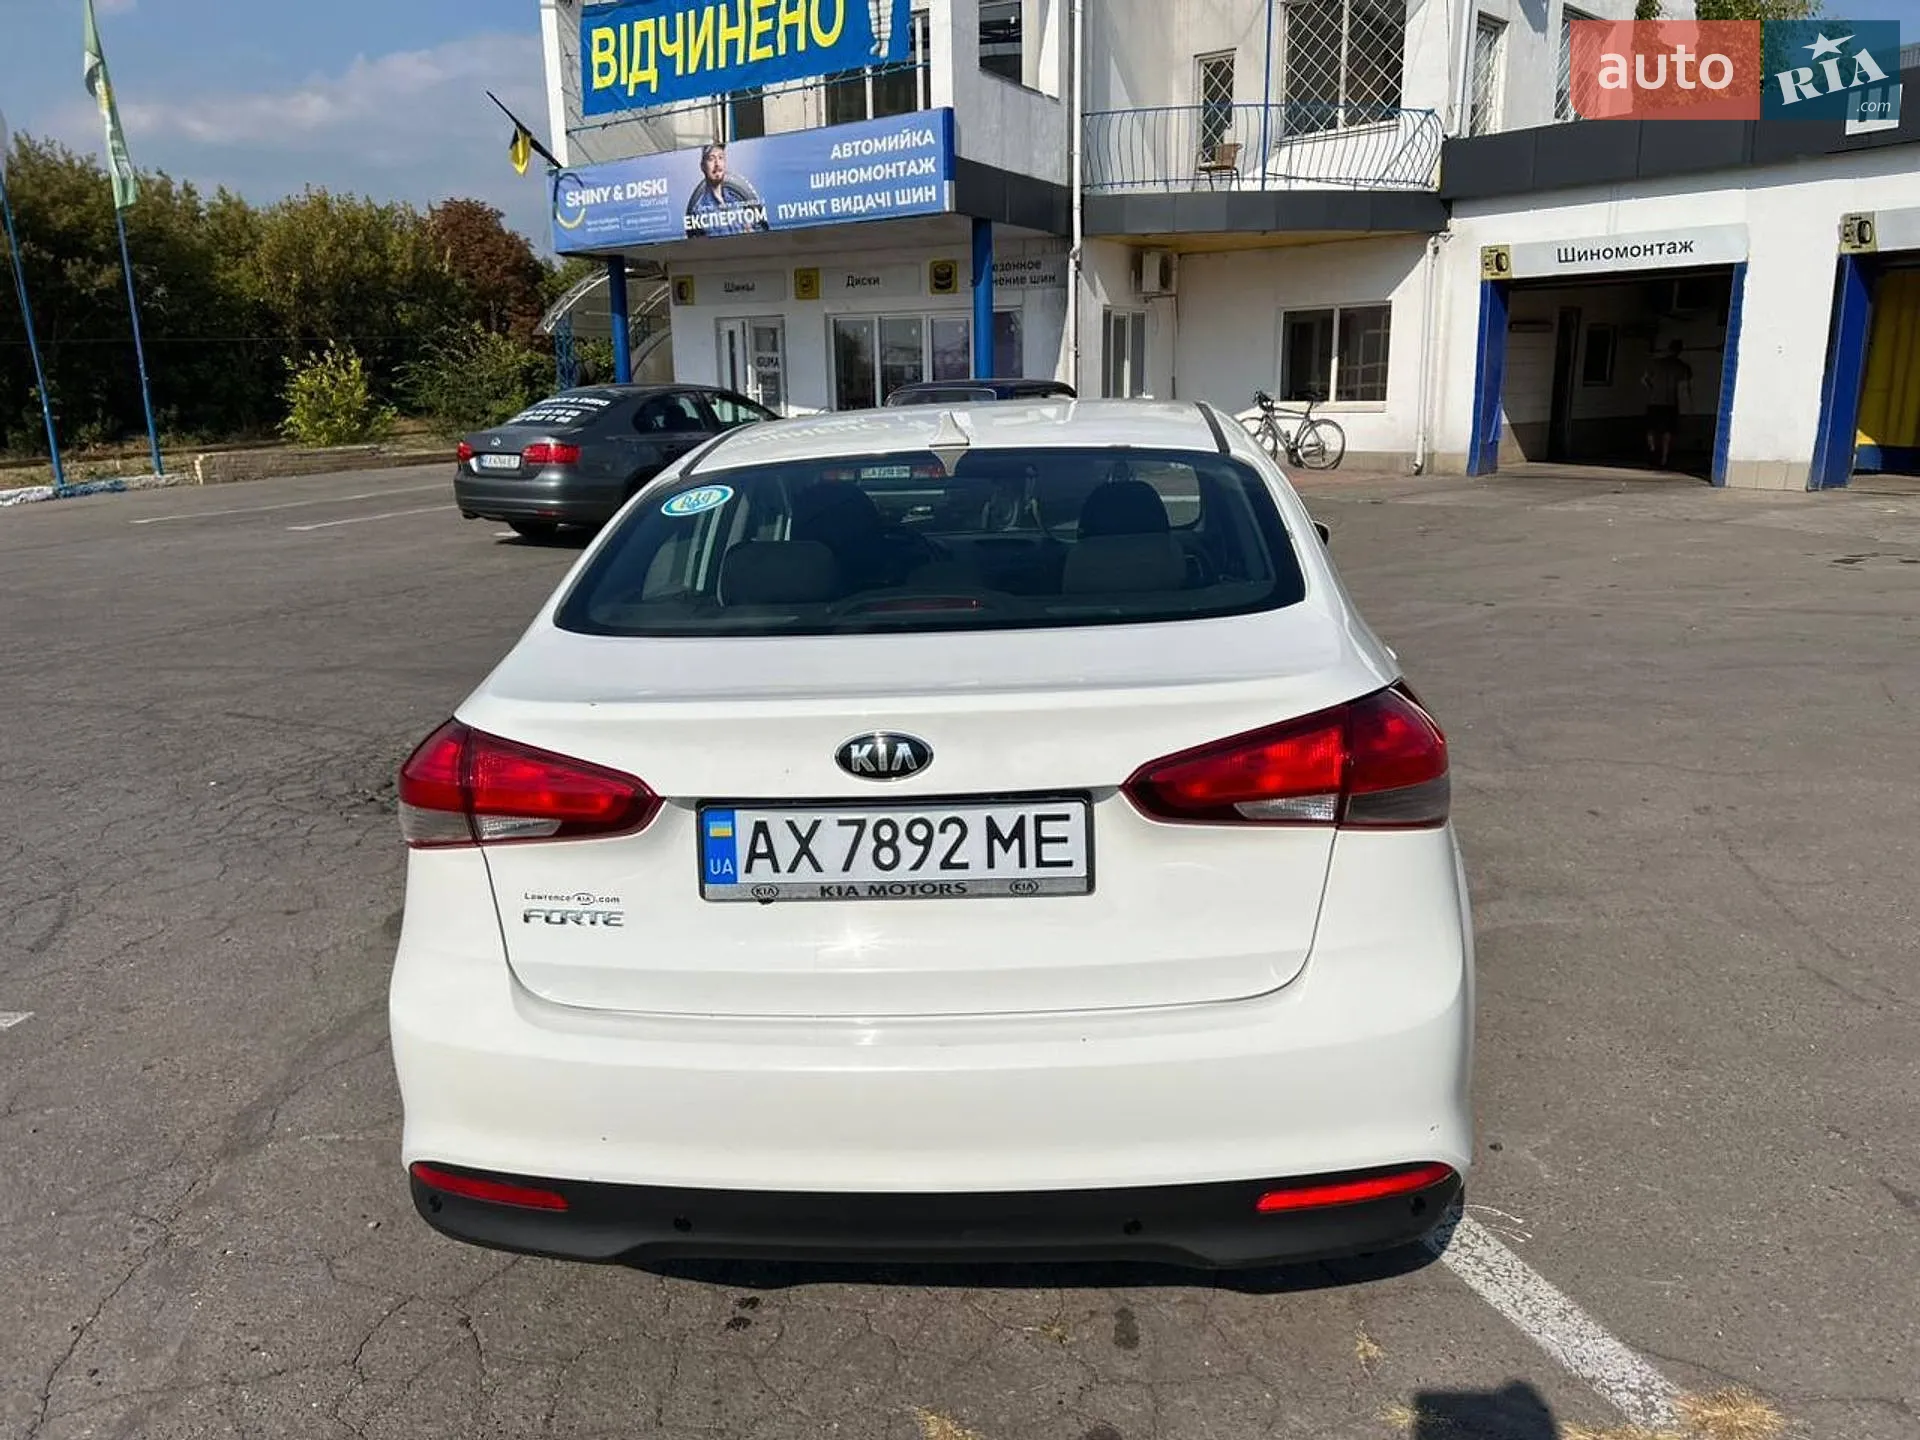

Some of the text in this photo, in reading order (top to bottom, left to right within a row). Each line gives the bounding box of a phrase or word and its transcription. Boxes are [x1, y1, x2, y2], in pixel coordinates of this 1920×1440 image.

[591, 0, 844, 96] ВІДЧИНЕНО
[831, 128, 935, 160] АВТОМИЙКА
[810, 156, 936, 189] ШИНОМОНТАЖ
[565, 178, 668, 208] SHINY & DISKI
[777, 199, 828, 220] ПУНКТ
[831, 191, 892, 214] ВИДАЧІ
[895, 185, 936, 206] ШИН
[684, 206, 768, 231] ЕКСПЕРТОМ
[1557, 239, 1694, 264] Шиномонтаж
[845, 275, 880, 288] Диски
[849, 741, 919, 773] KIA
[744, 813, 1074, 874] AX 7892 ME
[709, 858, 734, 875] UA
[754, 886, 777, 897] KIA
[819, 881, 967, 897] KIA MOTORS
[1013, 881, 1036, 893] KIA
[523, 908, 624, 927] FORTE
